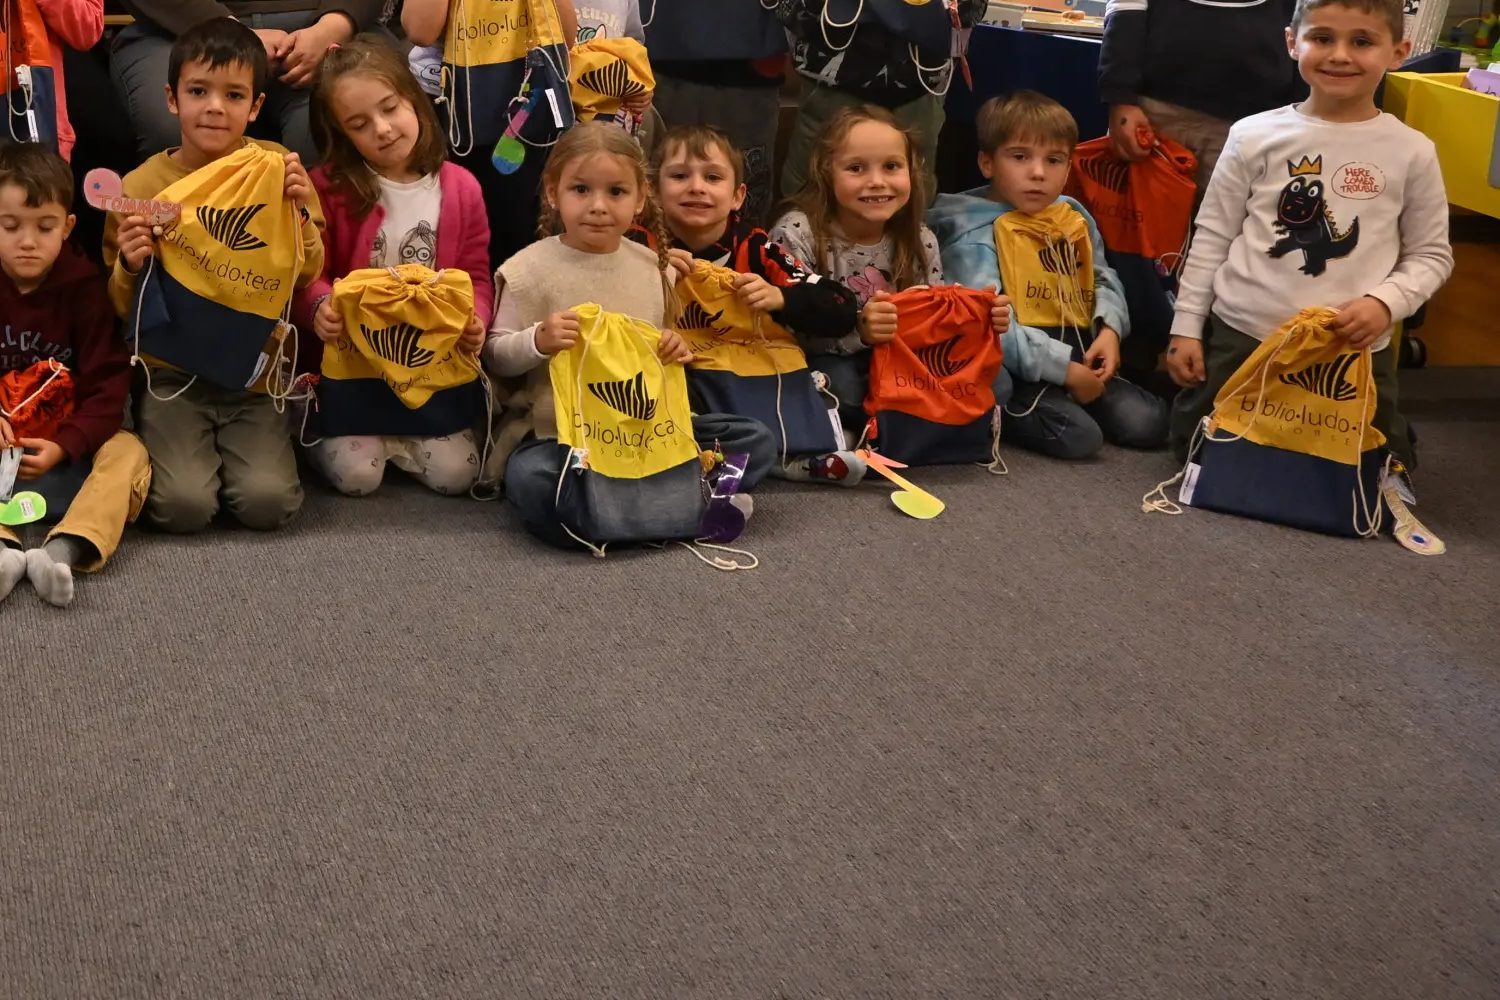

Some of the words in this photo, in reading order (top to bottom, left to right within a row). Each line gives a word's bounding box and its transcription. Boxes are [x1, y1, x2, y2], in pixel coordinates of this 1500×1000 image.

[1344, 166, 1371, 178] HERE
[1343, 174, 1375, 186] COMES
[1339, 182, 1380, 194] TROUBLE
[100, 196, 182, 215] TOMMASO
